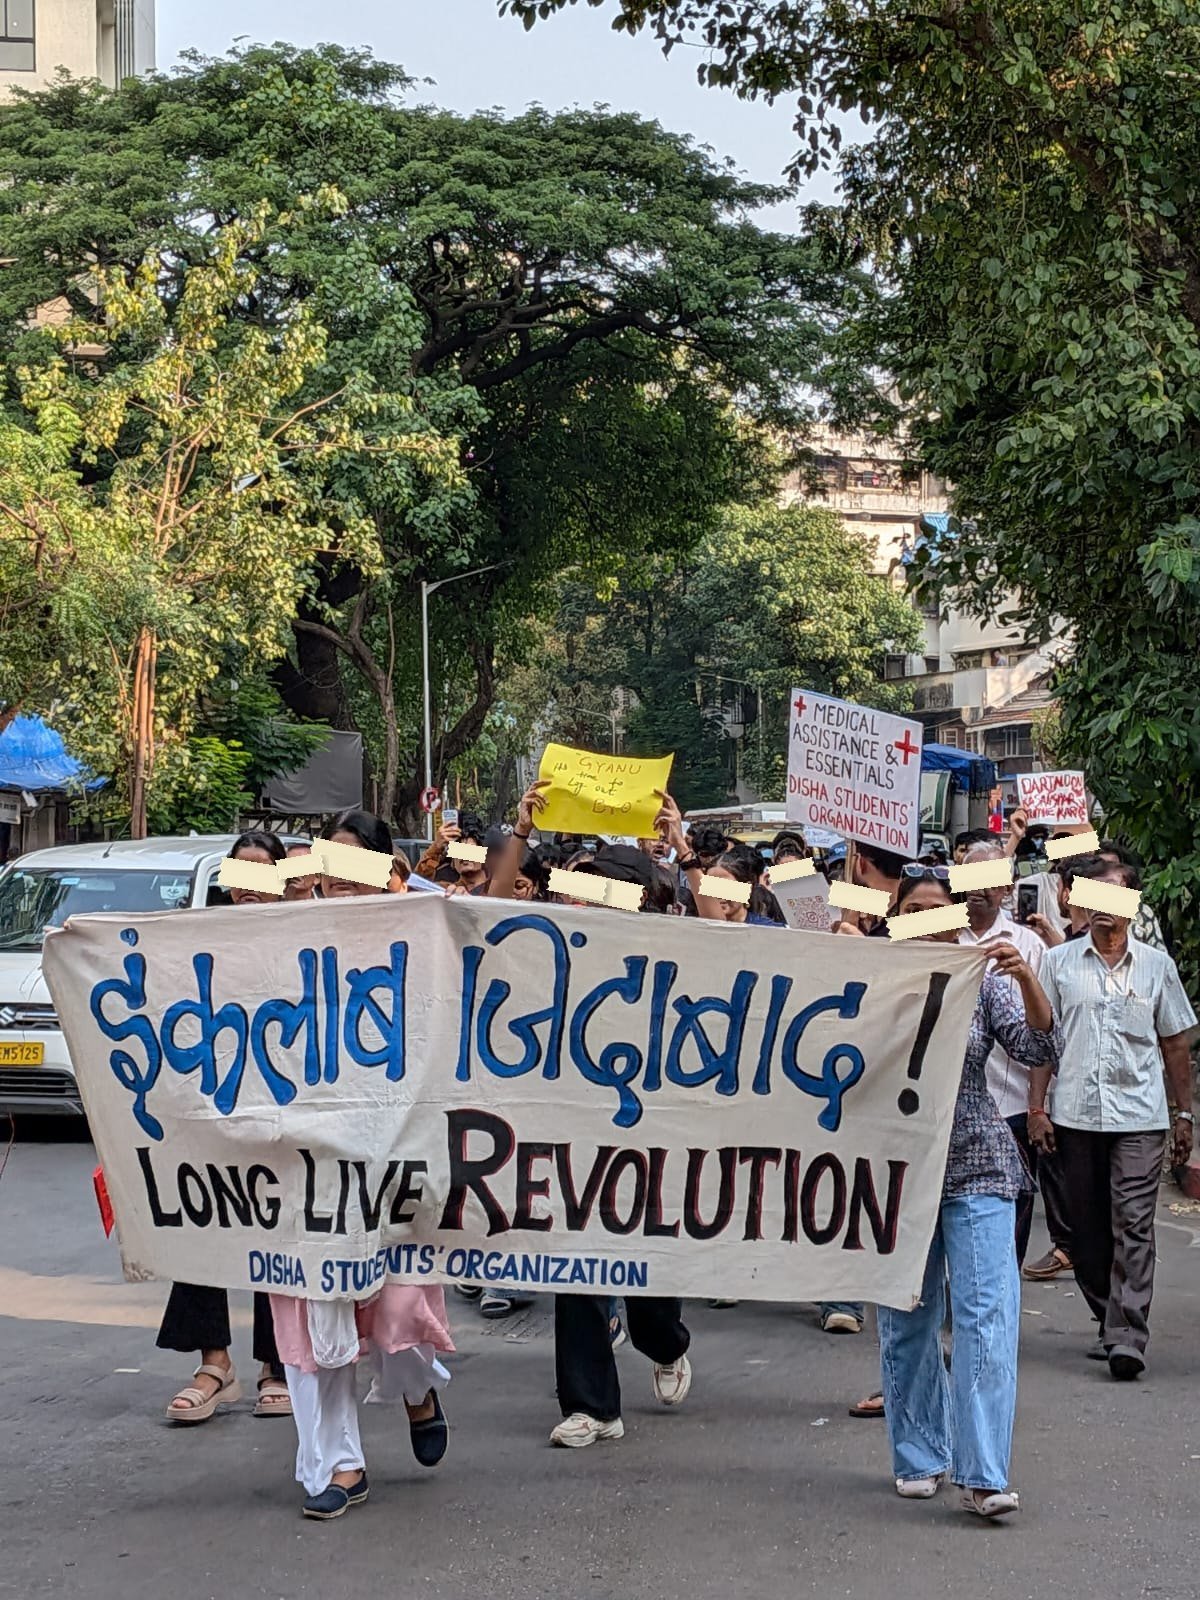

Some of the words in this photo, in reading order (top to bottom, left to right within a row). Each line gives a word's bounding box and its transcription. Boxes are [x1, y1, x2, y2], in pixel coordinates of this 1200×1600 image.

[813, 703, 879, 736] MEDICAL
[793, 723, 879, 761] ASSISTANCE
[885, 743, 899, 767] &
[806, 749, 894, 790] ESSENTIALS
[789, 774, 829, 803] DISHA
[834, 786, 914, 826] STUDENTS'
[808, 803, 909, 849] ORGANIZATION
[90, 927, 409, 1142] इंकलाब
[135, 1147, 282, 1229] LONG
[297, 1148, 428, 1235] LIVE
[438, 1108, 909, 1254] REVOLUTION
[249, 1249, 306, 1289] DISHA
[321, 1243, 445, 1293] STUDENTS'
[446, 1248, 648, 1288] ORGANIZATION
